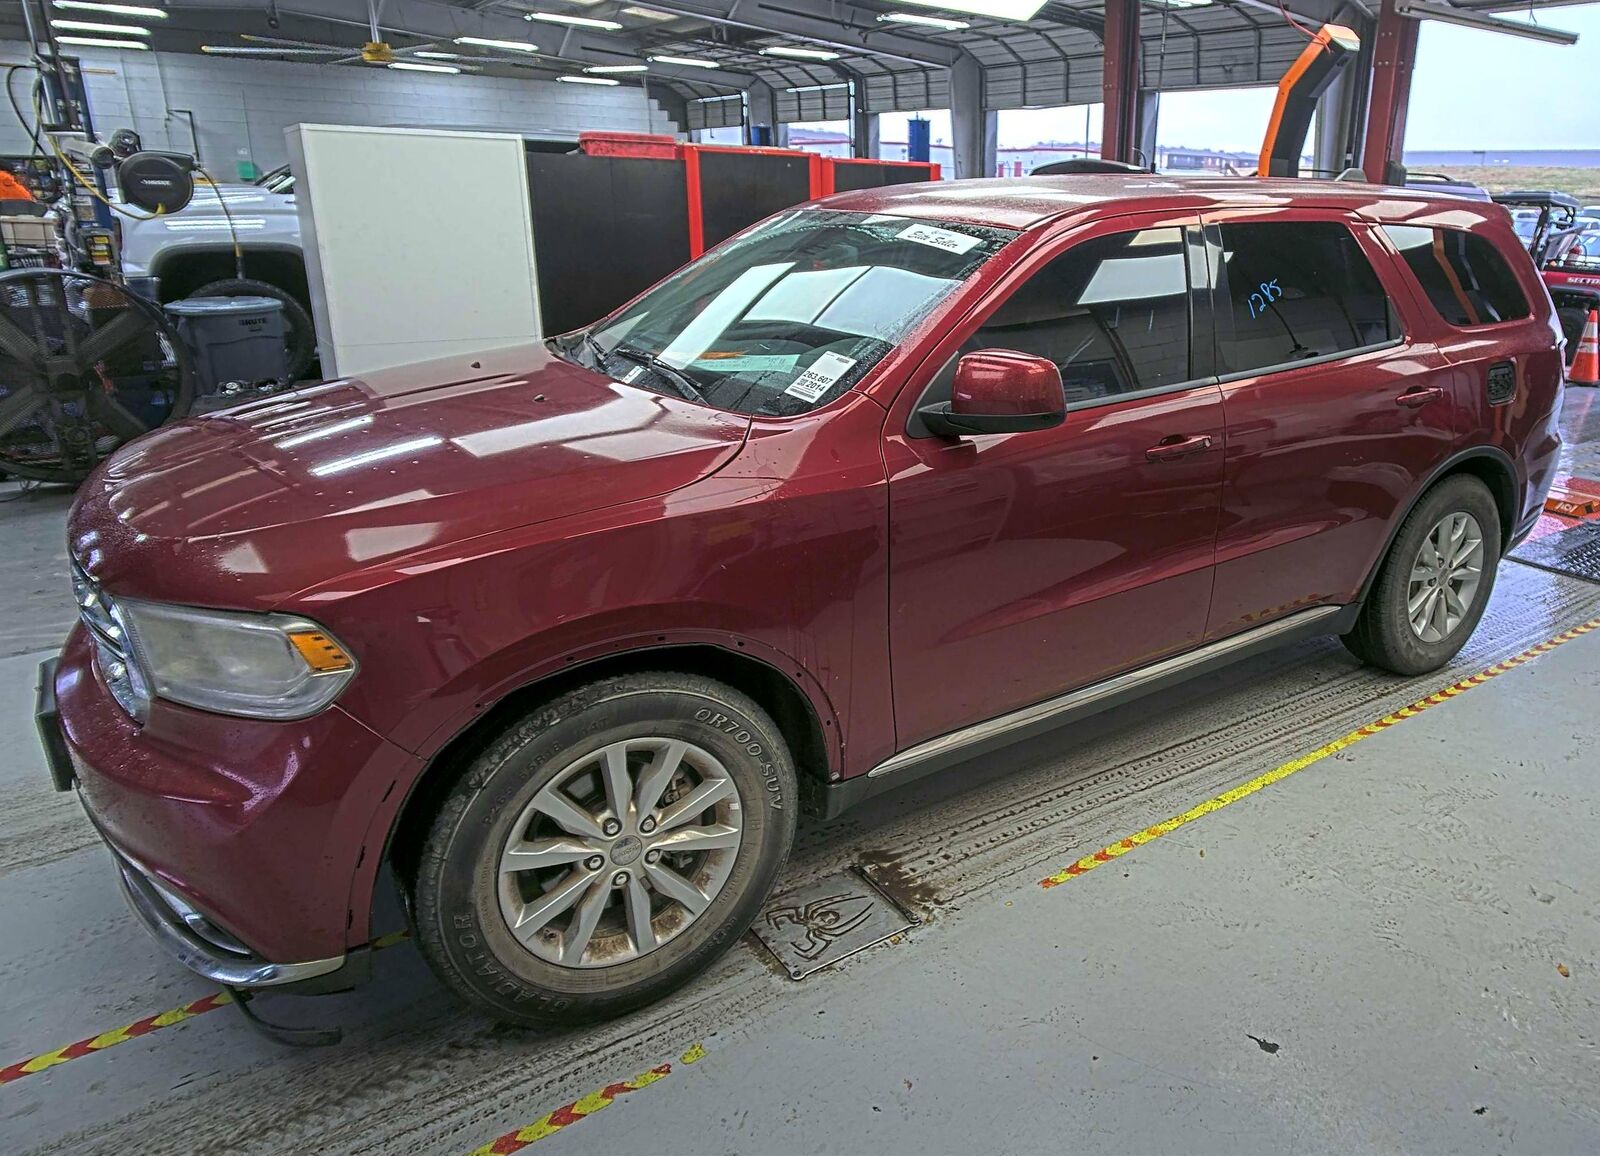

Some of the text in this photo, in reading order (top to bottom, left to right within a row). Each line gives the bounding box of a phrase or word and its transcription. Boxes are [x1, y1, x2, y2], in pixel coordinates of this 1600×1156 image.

[929, 237, 958, 248] Seller
[1567, 277, 1600, 285] SECTO
[1248, 278, 1282, 319] 1285
[803, 370, 833, 385] 263,607
[806, 381, 826, 392] 2014
[454, 912, 570, 1011] GLADIATOR
